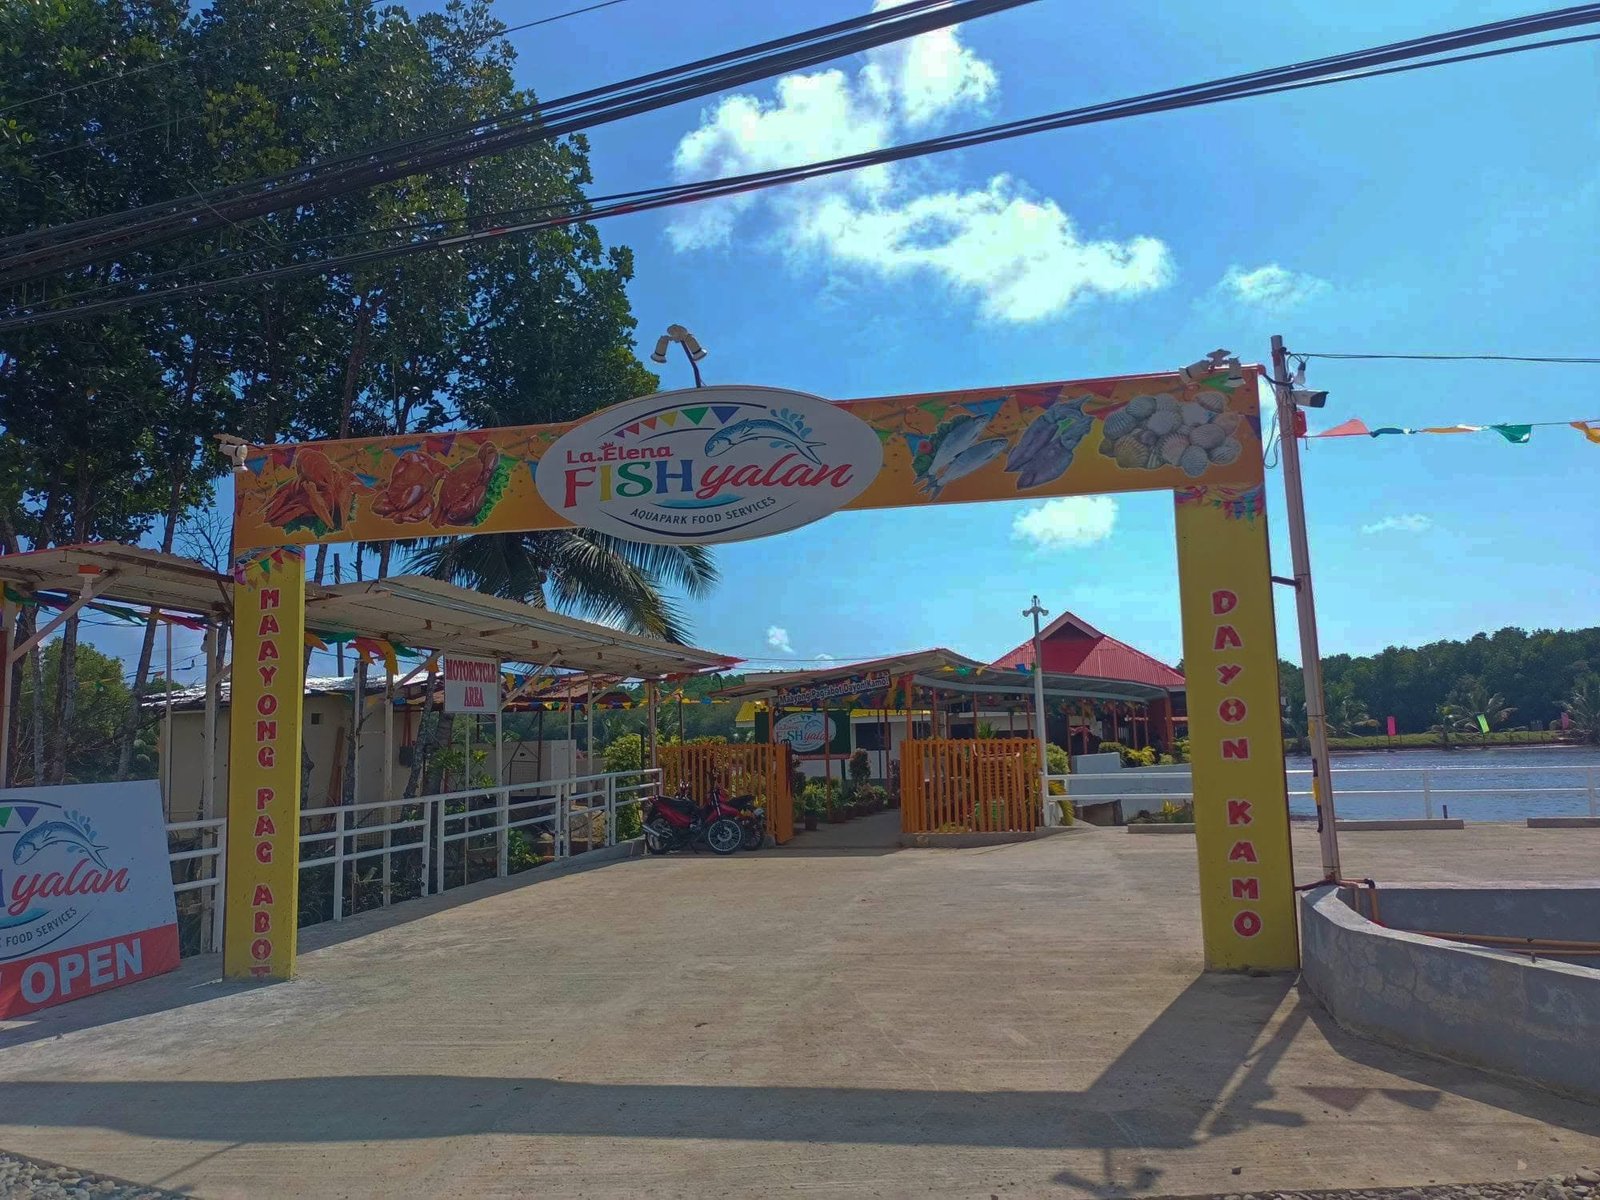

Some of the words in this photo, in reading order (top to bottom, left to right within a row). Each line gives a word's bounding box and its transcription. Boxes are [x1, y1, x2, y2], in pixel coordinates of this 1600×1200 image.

[630, 508, 687, 524] AQUAPARK
[692, 512, 722, 525] FOOD
[725, 496, 776, 520] SERVICES
[256, 588, 280, 768] MAAYONG
[446, 660, 496, 683] MOTORCYCLE
[464, 687, 484, 707] AREA
[1211, 589, 1250, 760] DAYON
[254, 787, 276, 864] PAG
[1227, 799, 1263, 938] KAMO
[6, 931, 33, 947] FOOD
[35, 906, 77, 937] SERVICES
[21, 938, 143, 1003] OPEN
